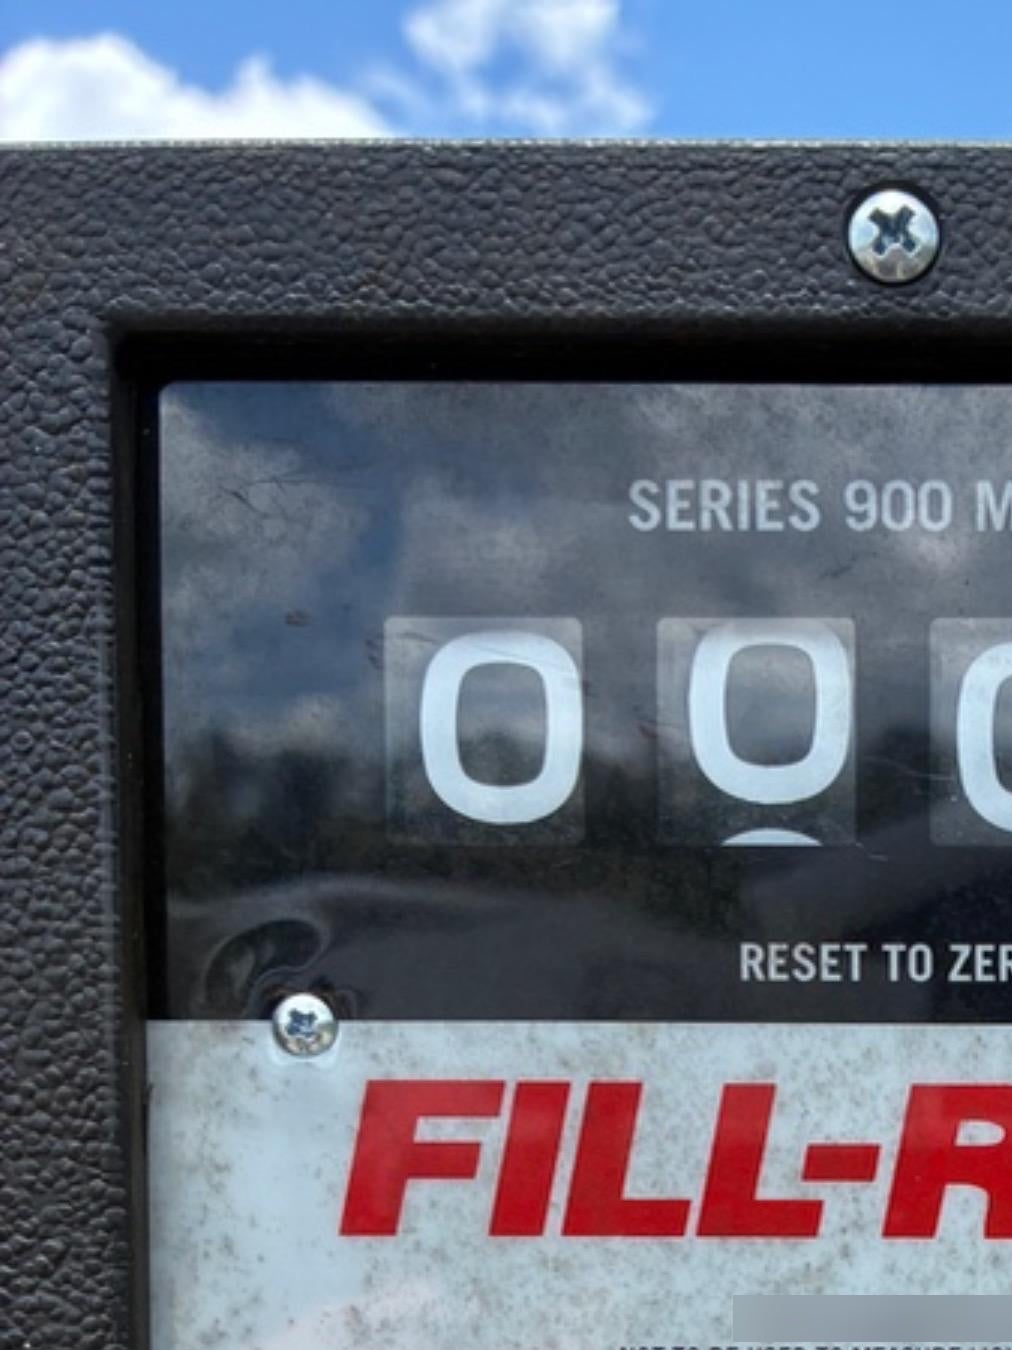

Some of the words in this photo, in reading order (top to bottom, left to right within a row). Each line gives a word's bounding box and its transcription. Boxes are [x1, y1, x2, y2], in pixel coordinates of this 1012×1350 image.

[628, 479, 821, 533] SERIES
[844, 480, 952, 532] 900
[740, 942, 867, 983] RESET
[881, 942, 933, 983] TO
